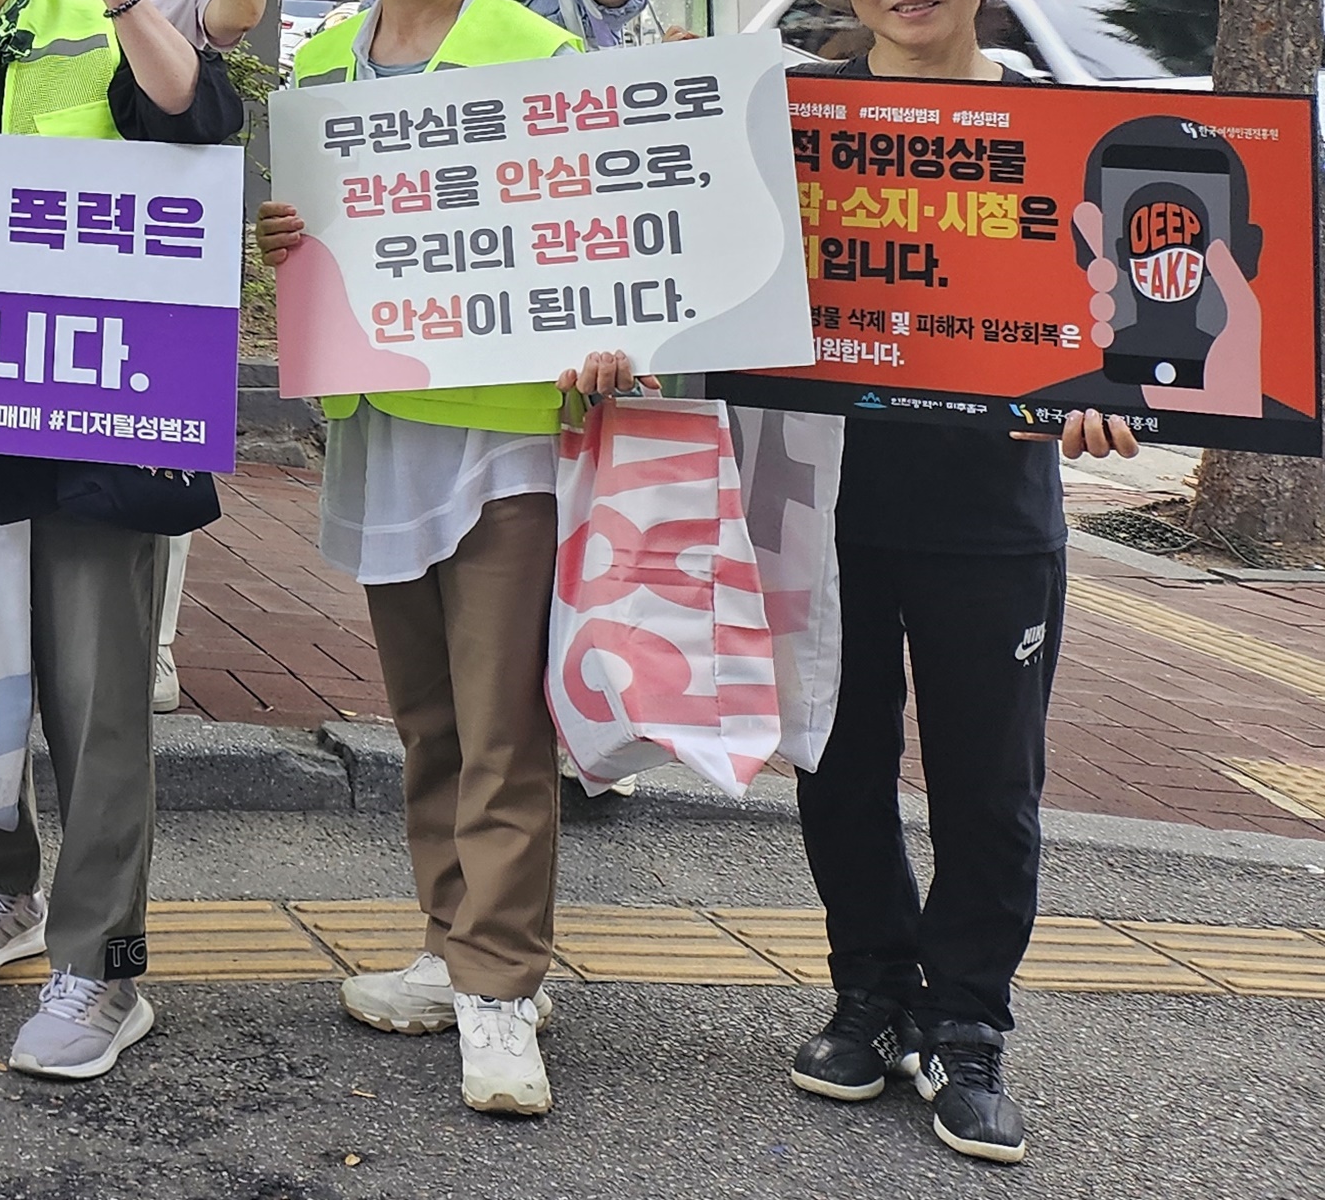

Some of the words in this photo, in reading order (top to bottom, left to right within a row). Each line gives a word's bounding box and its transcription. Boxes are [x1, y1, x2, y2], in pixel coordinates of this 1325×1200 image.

[323, 98, 506, 157] 무관심을
[522, 75, 724, 137] 관심으로
[859, 106, 940, 124] #디지털성범죄
[953, 110, 1010, 128] #합성편집
[342, 164, 480, 219] 관심을
[496, 144, 710, 204] 안심으로,
[831, 130, 1026, 184] 허위영상물
[8, 187, 206, 259] 폭력은
[374, 224, 514, 278] 우리의
[531, 209, 683, 267] 관심이
[1130, 202, 1200, 254] DEEP
[1134, 251, 1200, 299] FAKE
[371, 290, 512, 345] 안심이
[526, 277, 696, 333] 됩니다.
[848, 309, 885, 333] 삭제
[891, 311, 910, 335] 및
[916, 314, 974, 340] 피해자
[982, 319, 1082, 349] 일상회복은
